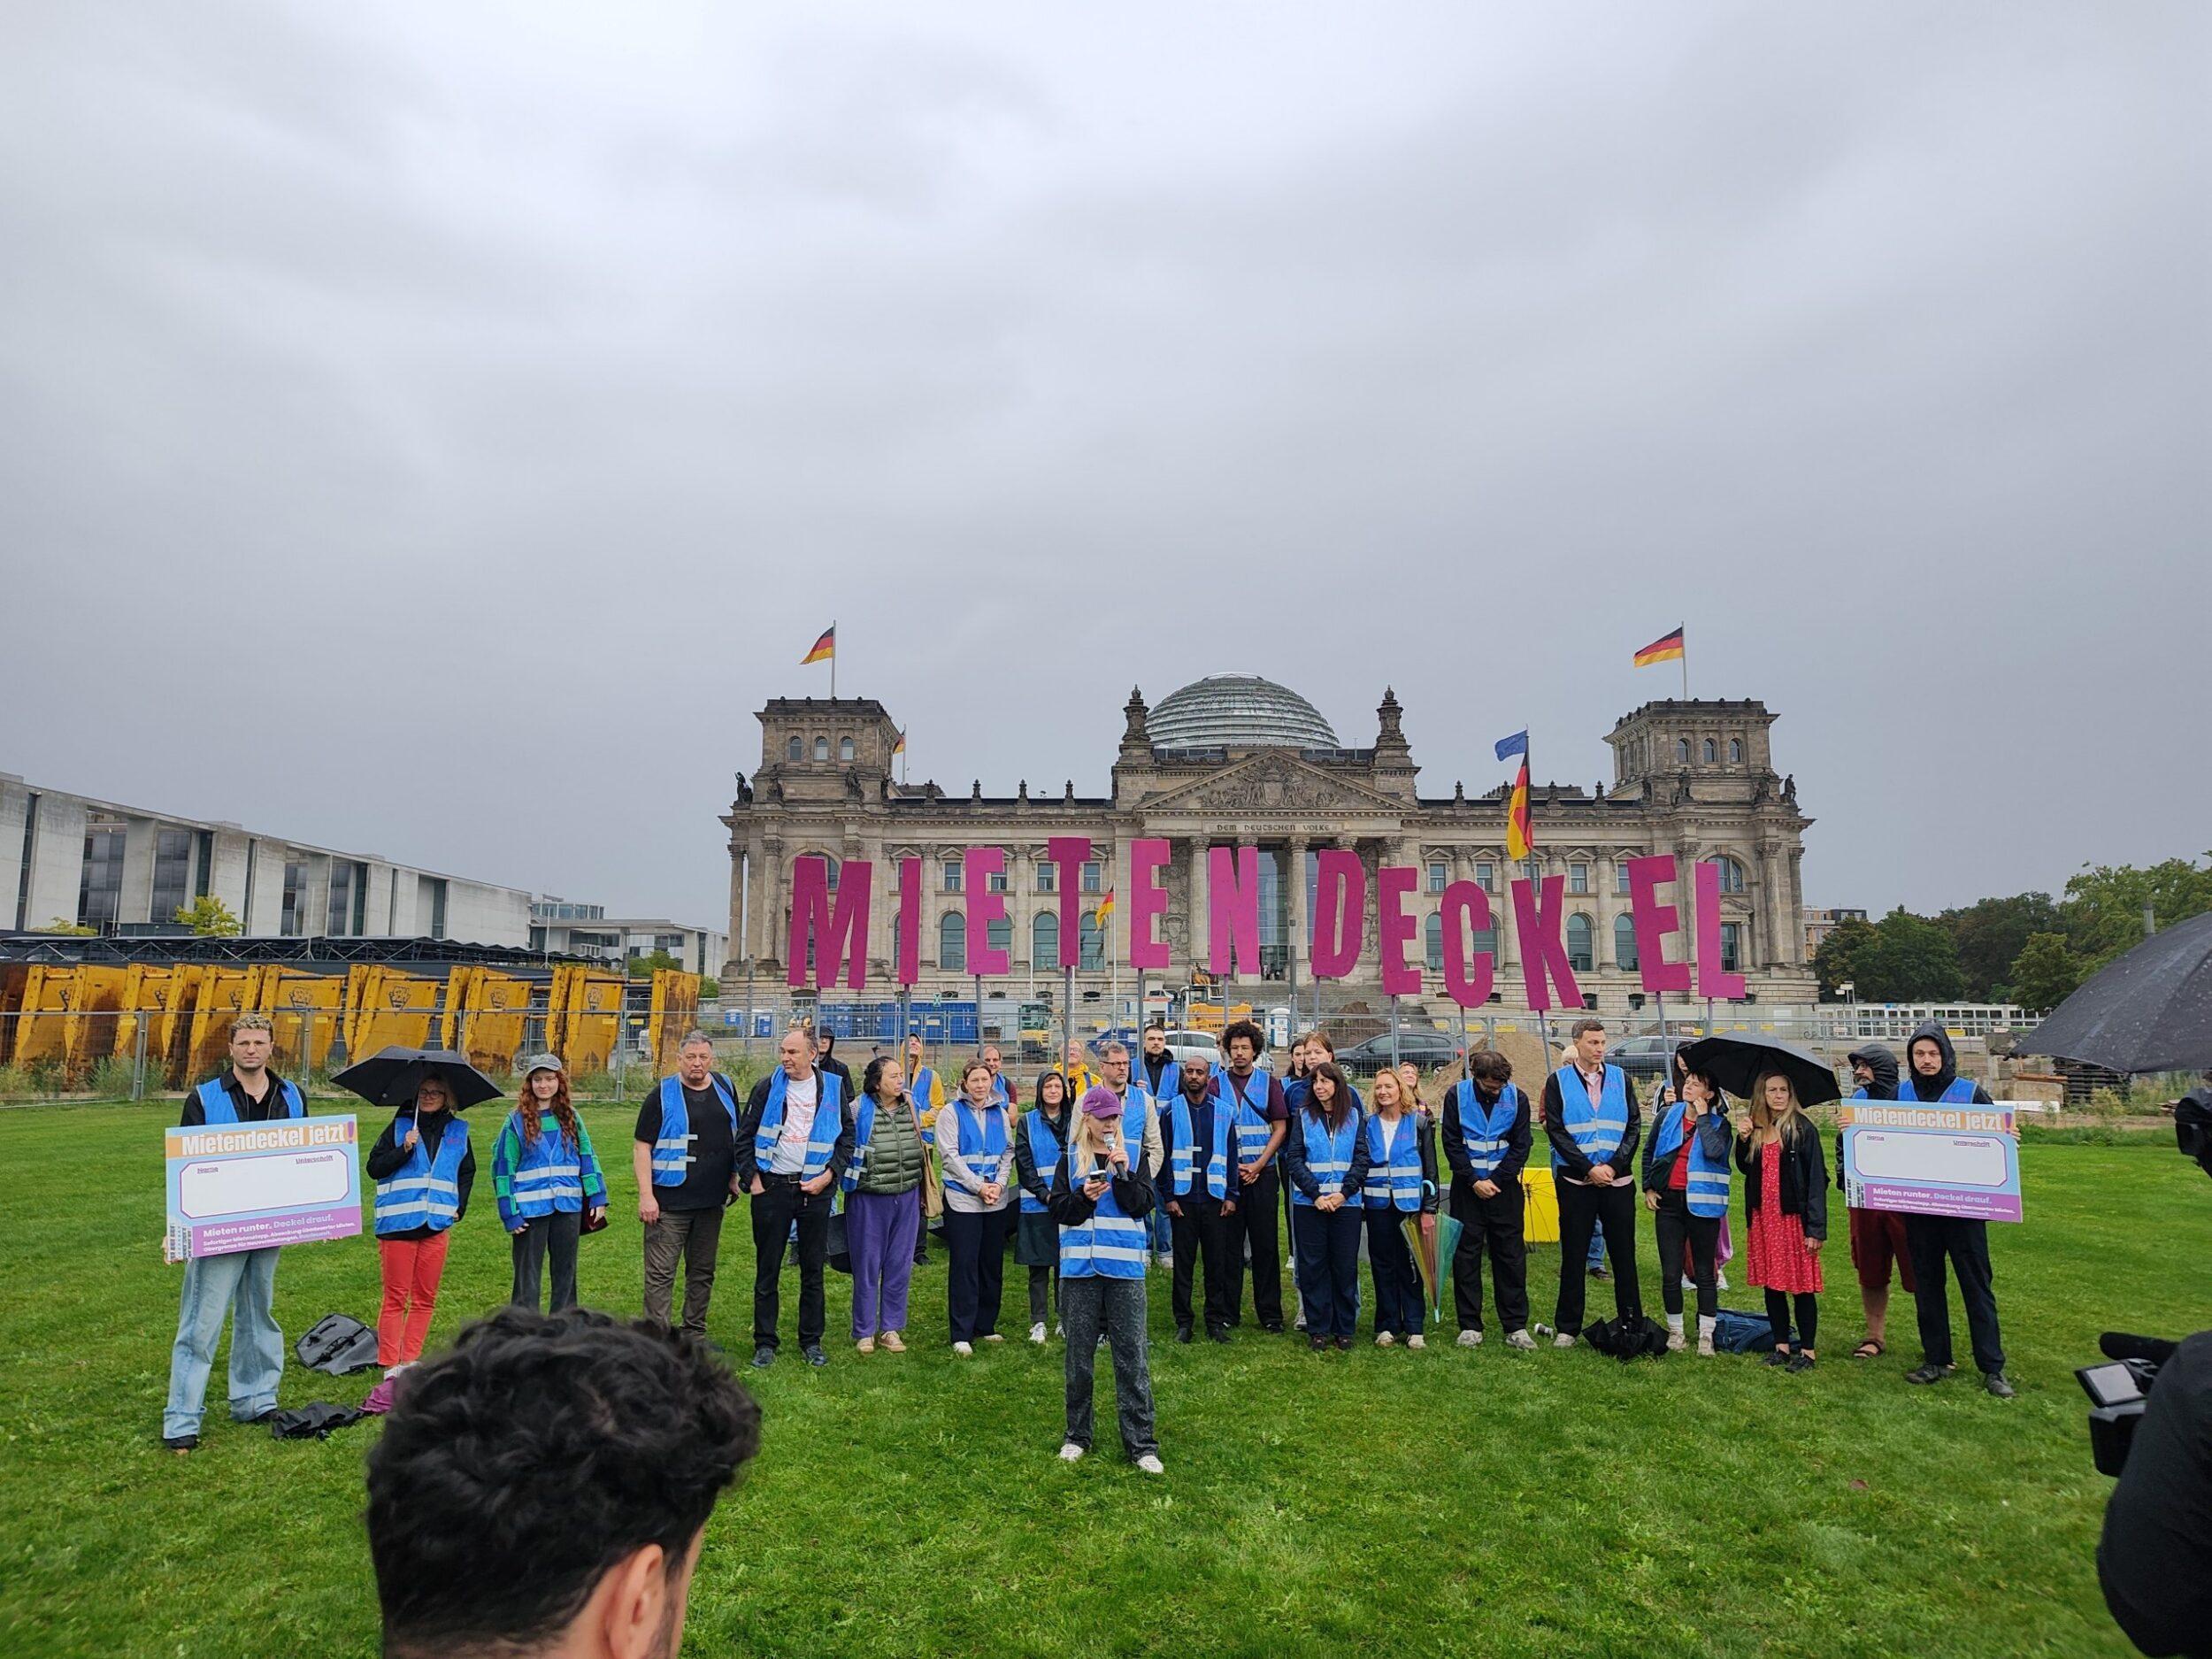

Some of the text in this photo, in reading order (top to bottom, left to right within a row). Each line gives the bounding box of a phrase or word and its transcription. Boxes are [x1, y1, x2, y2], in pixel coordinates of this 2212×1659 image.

[1854, 1107, 2012, 1133] Mietendeckel jetzt!
[181, 1121, 355, 1156] Mietendeckel jetzt!
[296, 1154, 334, 1164] Unterschrift
[1872, 1187, 1902, 1196] Mieten
[1933, 1193, 1964, 1202] Deckel
[203, 1214, 334, 1238] Mieten runter. Deckel drauf.
